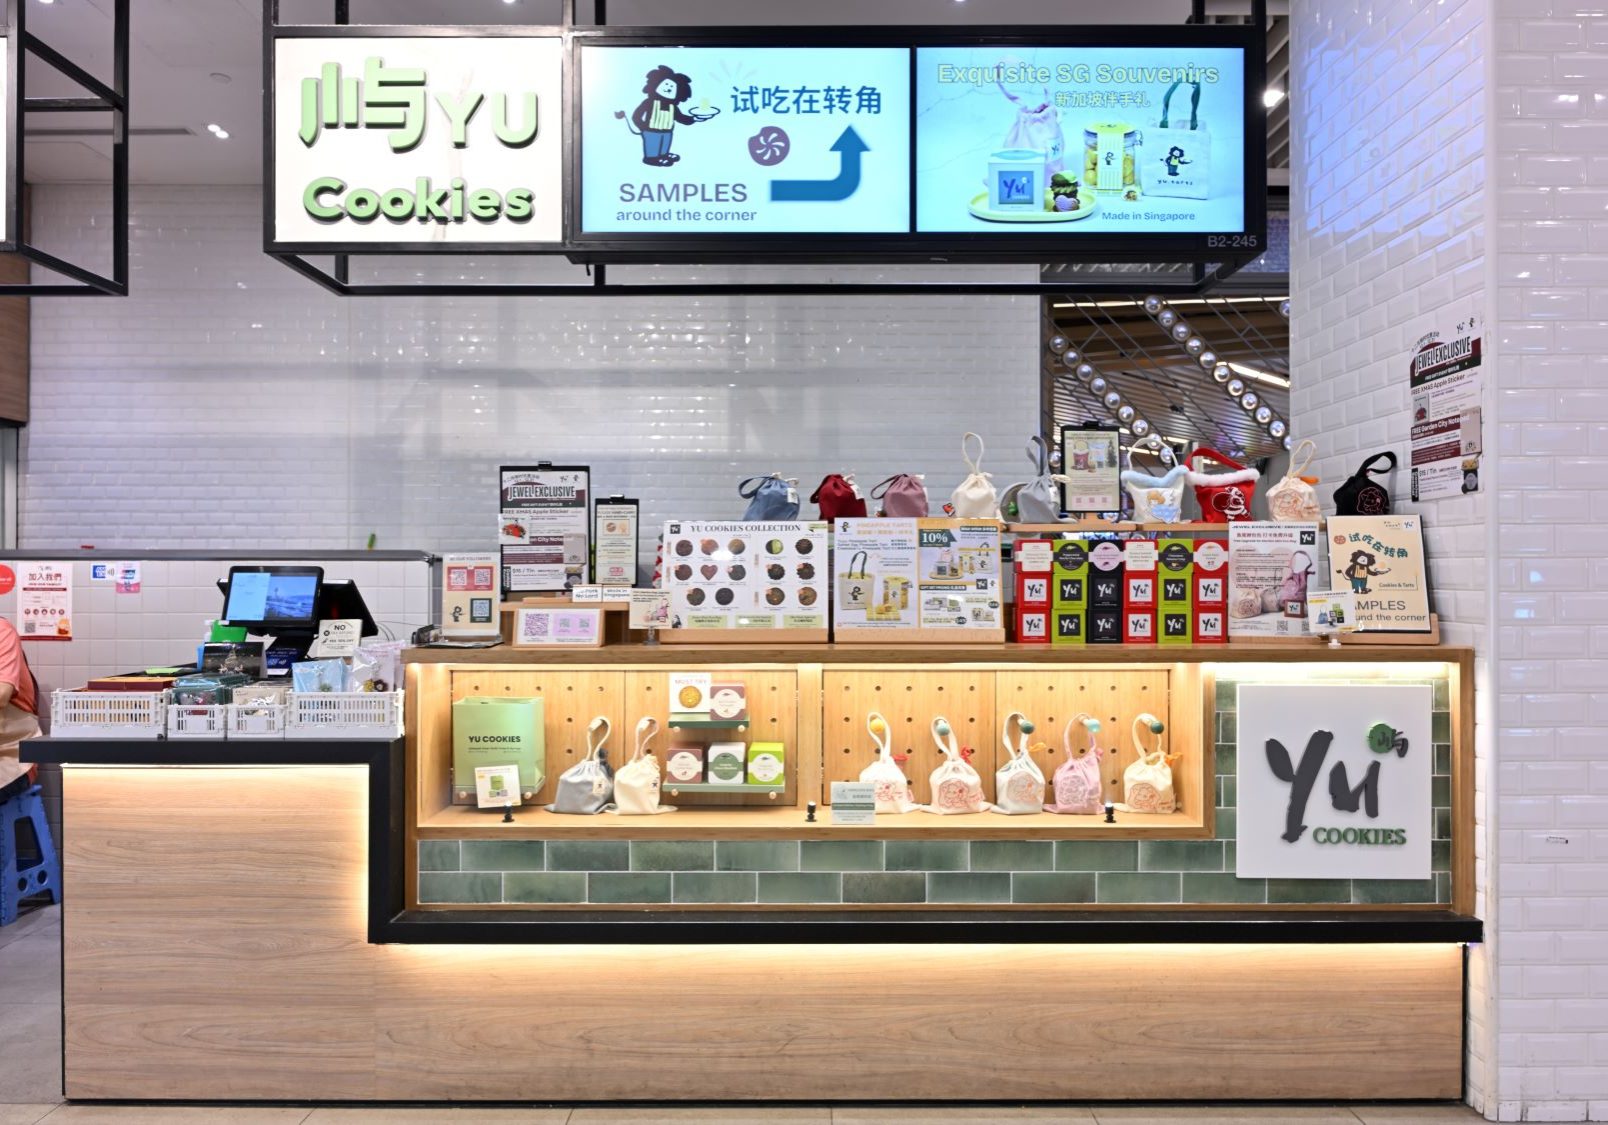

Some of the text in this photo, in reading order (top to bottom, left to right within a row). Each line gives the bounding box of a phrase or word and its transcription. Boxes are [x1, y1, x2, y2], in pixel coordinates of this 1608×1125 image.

[937, 63, 1219, 86] Exquisite SG Souvenirs
[730, 85, 882, 115] 试吃在转角
[1054, 91, 1150, 108] 新加坡伴手礼
[434, 91, 539, 149] YU
[302, 176, 536, 225] Cookies
[619, 183, 748, 203] SAMPLES
[616, 209, 757, 221] around the corner
[1102, 211, 1196, 222] Made in Singapore
[1207, 235, 1257, 247] B2-245
[1435, 336, 1471, 361] EXCLUSIVE
[1411, 374, 1465, 396] FREE XMAS Apple Sticker
[1438, 420, 1448, 428] City
[507, 486, 575, 501] JEWEL EXCLUSIVE
[745, 524, 801, 532] COLLECTION
[922, 532, 948, 543] 10%
[1348, 532, 1408, 558] 试吃在转角
[1376, 613, 1391, 621] the
[468, 735, 521, 743] YU COOKIES
[1265, 729, 1381, 843] Yu
[1312, 826, 1408, 846] COOKIES
